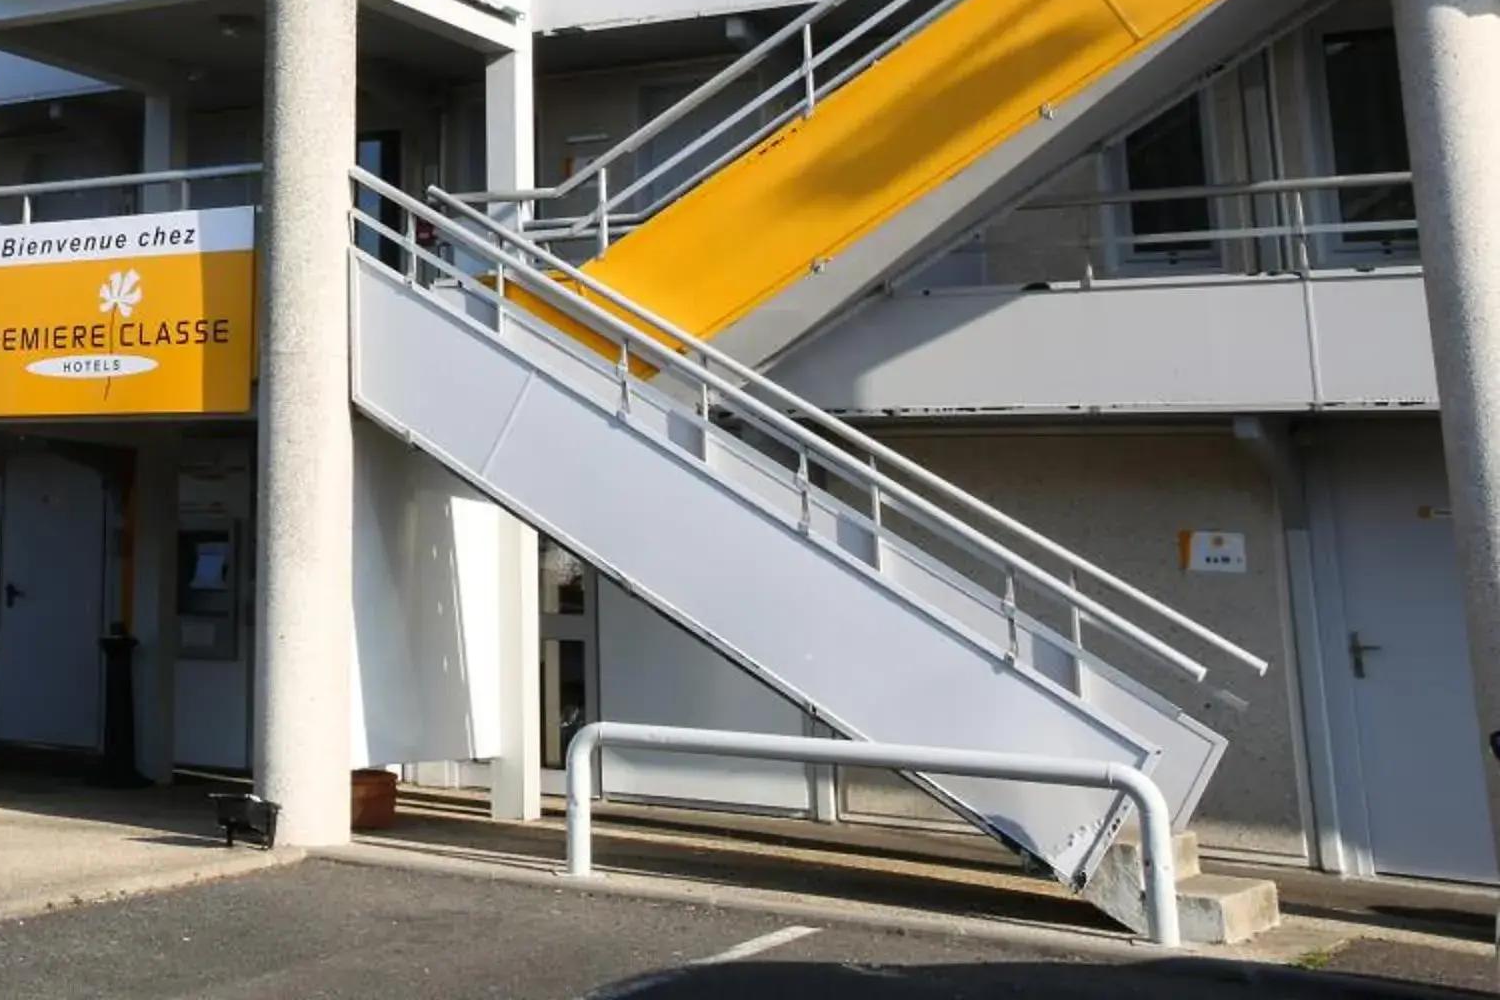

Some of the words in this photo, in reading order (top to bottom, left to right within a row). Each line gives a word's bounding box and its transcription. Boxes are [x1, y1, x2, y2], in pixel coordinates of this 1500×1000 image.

[1, 233, 127, 258] Bienvenue
[137, 226, 196, 248] chez
[119, 319, 230, 347] CLASSE
[62, 359, 121, 373] HOTELS
